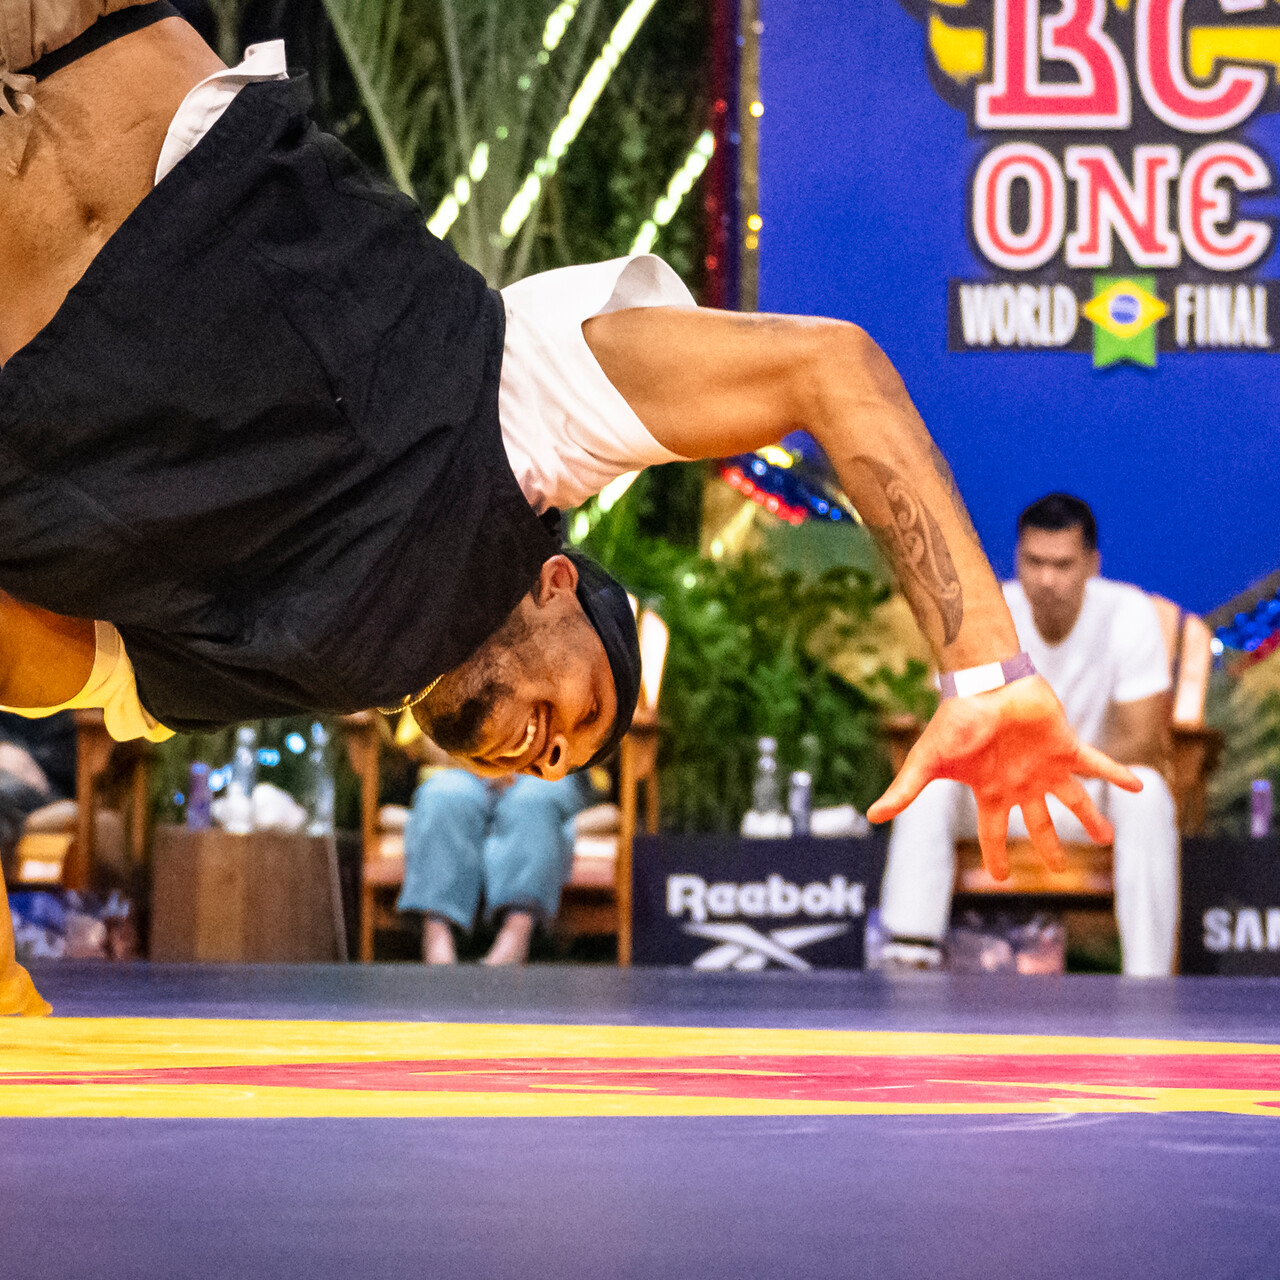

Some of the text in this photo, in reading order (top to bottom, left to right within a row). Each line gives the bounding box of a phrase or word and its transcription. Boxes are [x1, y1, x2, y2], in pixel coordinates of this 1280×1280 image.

[974, 142, 1271, 270] ONE
[959, 282, 1271, 348] WORLD FINAL
[666, 872, 865, 923] Reebok
